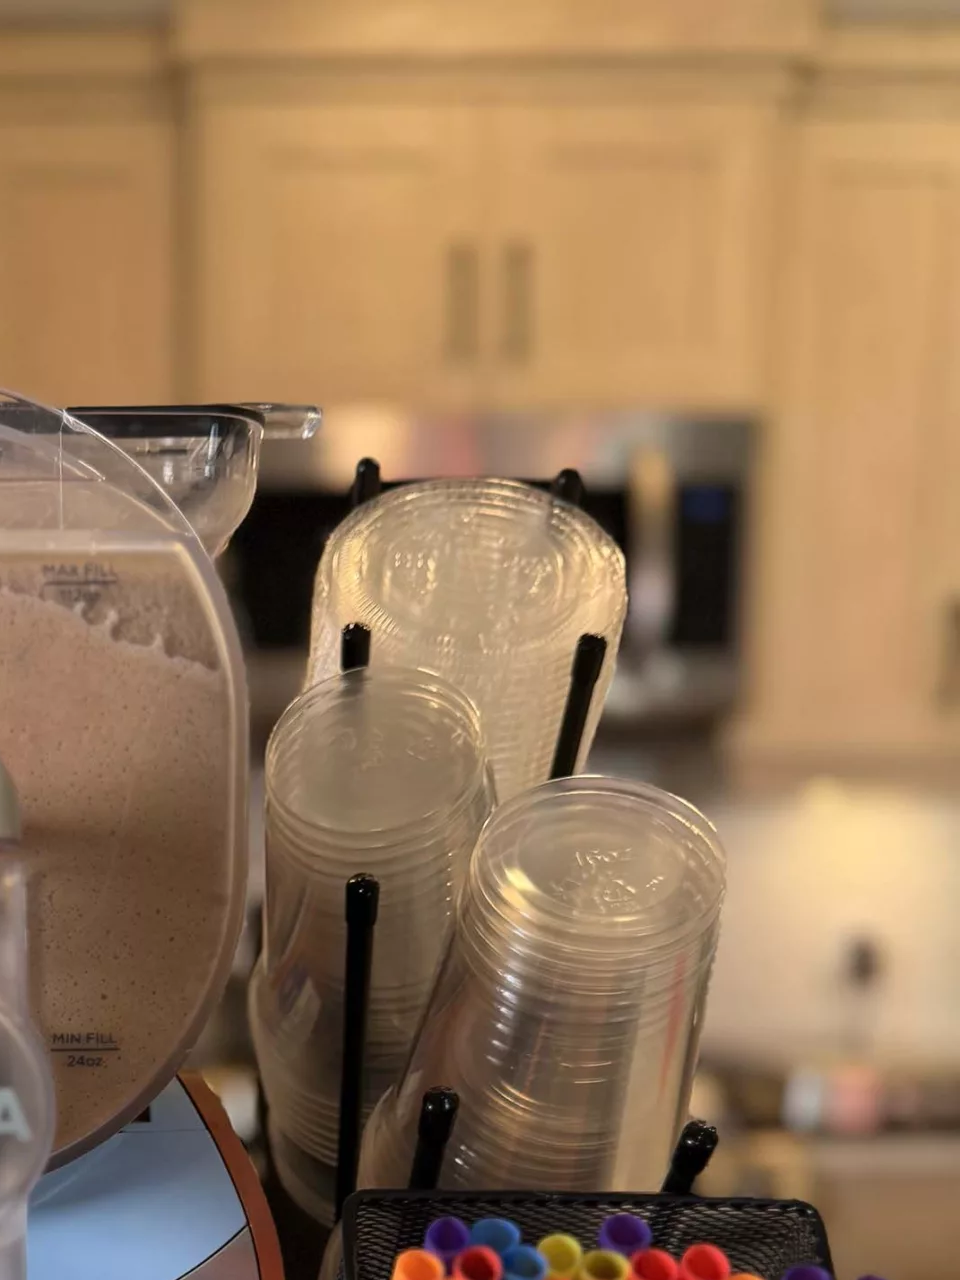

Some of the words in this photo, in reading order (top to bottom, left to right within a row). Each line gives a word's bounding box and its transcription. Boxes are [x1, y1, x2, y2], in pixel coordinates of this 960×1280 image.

[51, 1032, 83, 1045] MIN
[86, 1032, 117, 1045] FILL
[66, 1054, 104, 1067] 24oz
